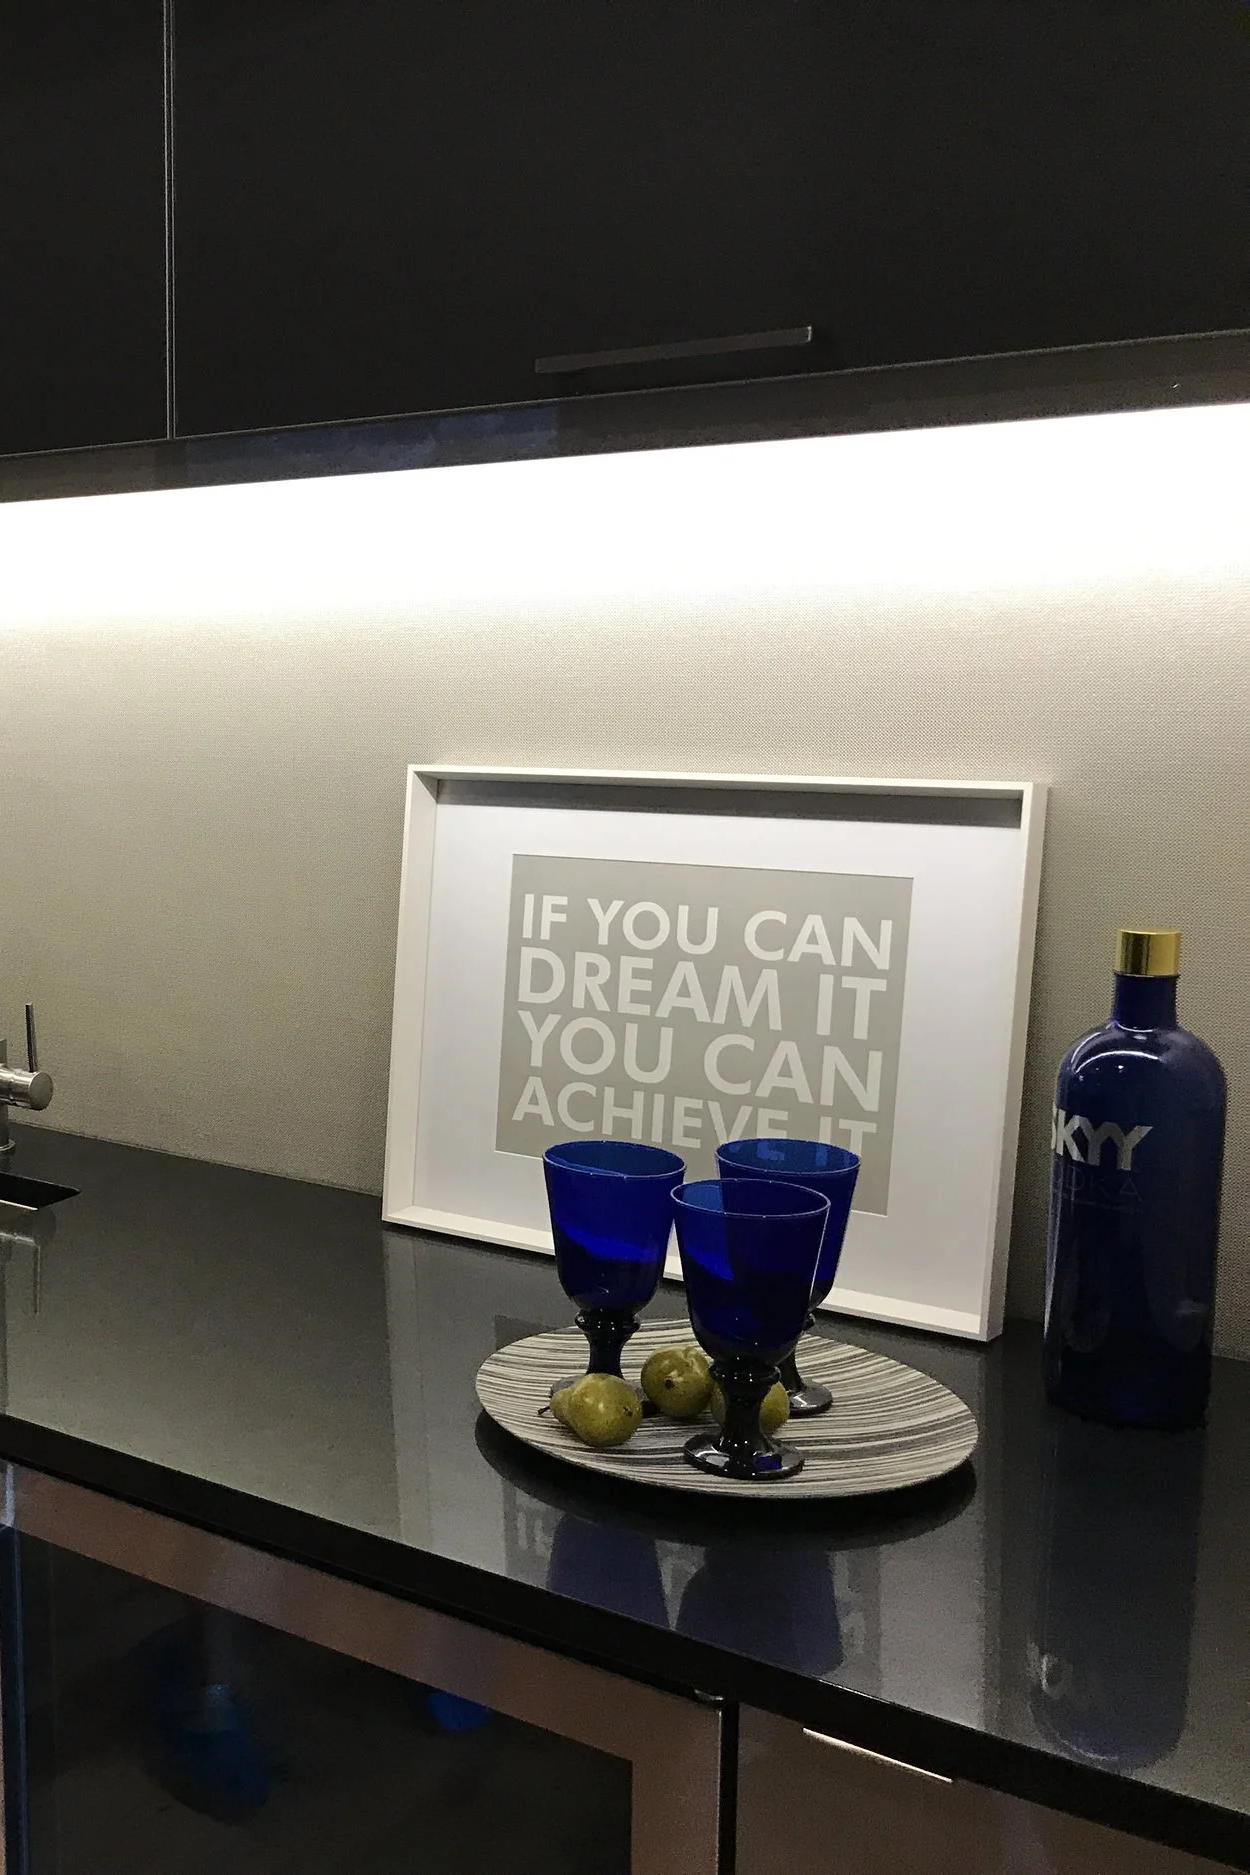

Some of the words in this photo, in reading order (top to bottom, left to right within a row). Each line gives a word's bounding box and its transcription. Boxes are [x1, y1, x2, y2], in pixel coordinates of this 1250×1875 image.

[522, 893, 568, 940] IF
[586, 898, 719, 955] YOU
[743, 910, 893, 970] CAN
[517, 946, 783, 1031] DREAM
[816, 973, 887, 1040] IT
[517, 1009, 674, 1084] YOU
[703, 1033, 883, 1113] CAN
[511, 1076, 789, 1152] ACHIEVE
